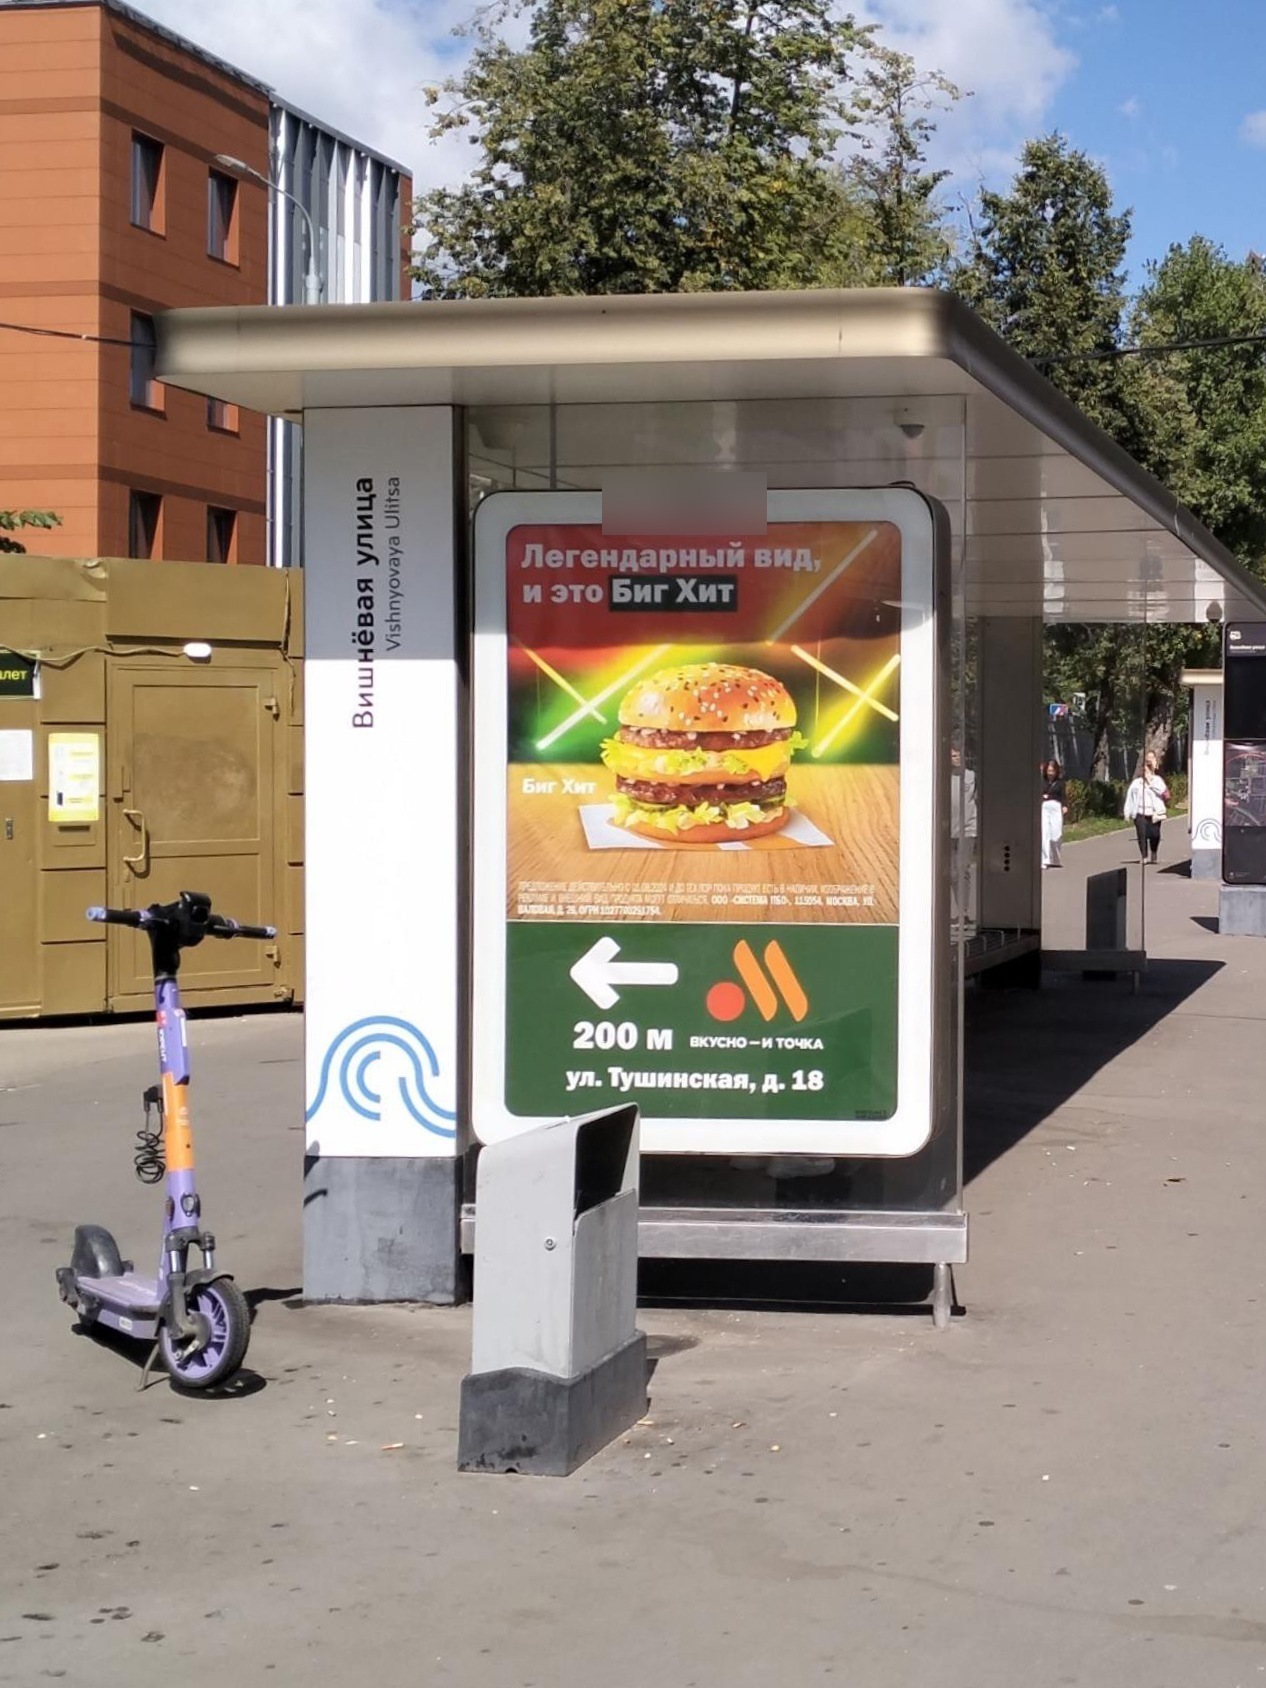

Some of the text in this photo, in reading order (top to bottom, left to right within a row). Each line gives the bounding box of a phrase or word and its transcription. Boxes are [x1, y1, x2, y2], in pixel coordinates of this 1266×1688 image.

[384, 476, 404, 652] Vishnyovaya Ulitsa
[521, 541, 822, 573] Легендарный вид,
[352, 477, 380, 729] Вишнёвая улица
[522, 578, 734, 604] и это Биг Хит
[522, 778, 597, 794] Биг Хит
[573, 1021, 673, 1050] 200 м
[776, 1037, 824, 1050] ТОЧКА
[565, 1067, 824, 1094] ул. Тушинская, д. 18
